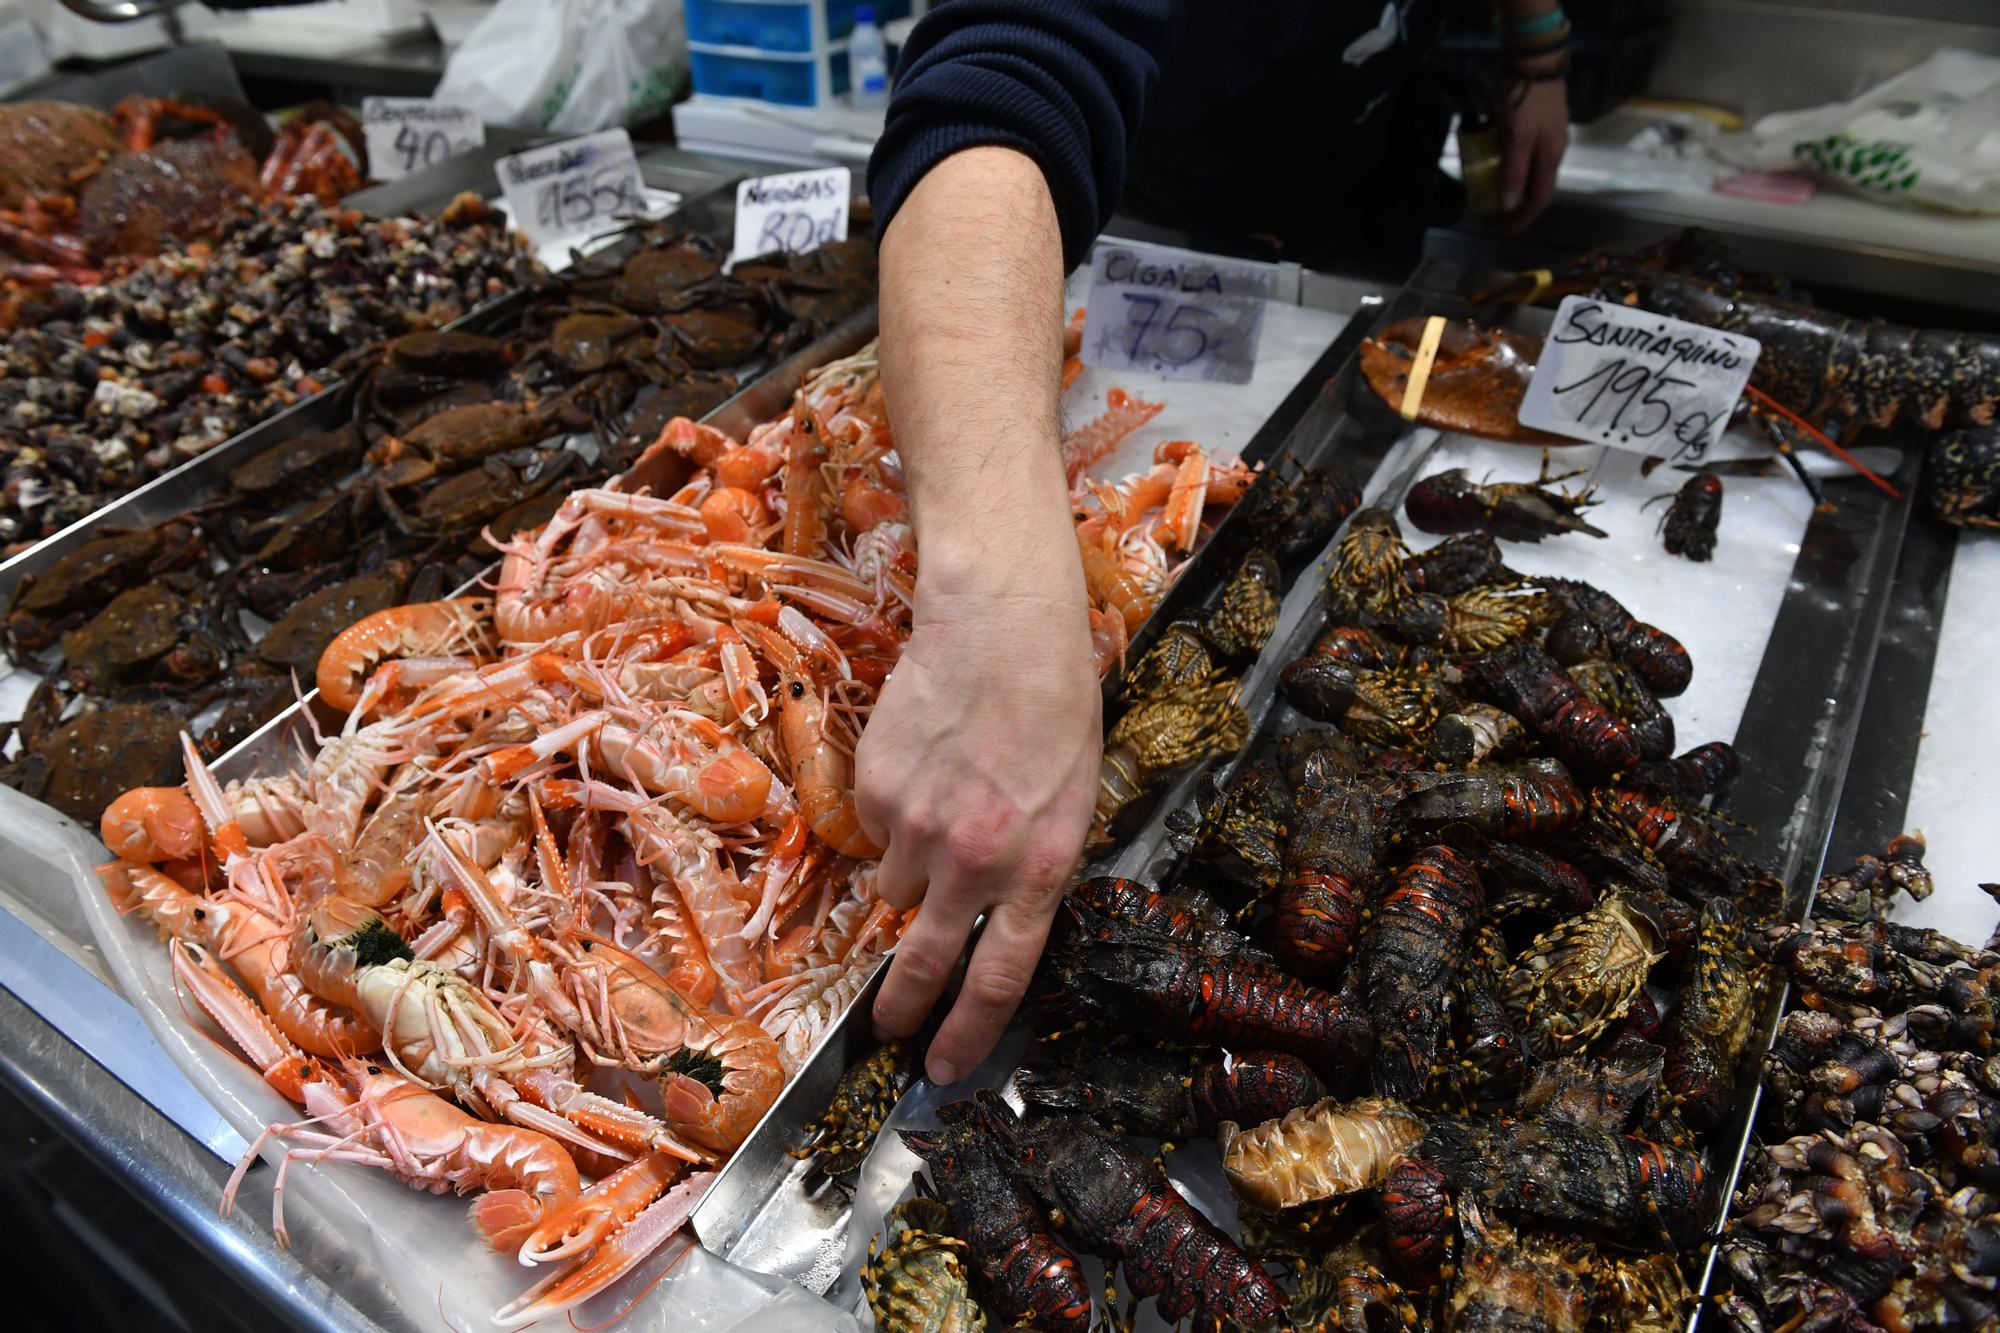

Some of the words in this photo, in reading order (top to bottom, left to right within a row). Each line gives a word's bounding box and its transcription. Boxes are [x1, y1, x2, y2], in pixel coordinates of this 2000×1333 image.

[394, 128, 452, 170] 40
[1105, 256, 1222, 295] CIGALA
[1123, 292, 1218, 367] 75
[1553, 358, 1697, 437] 195
